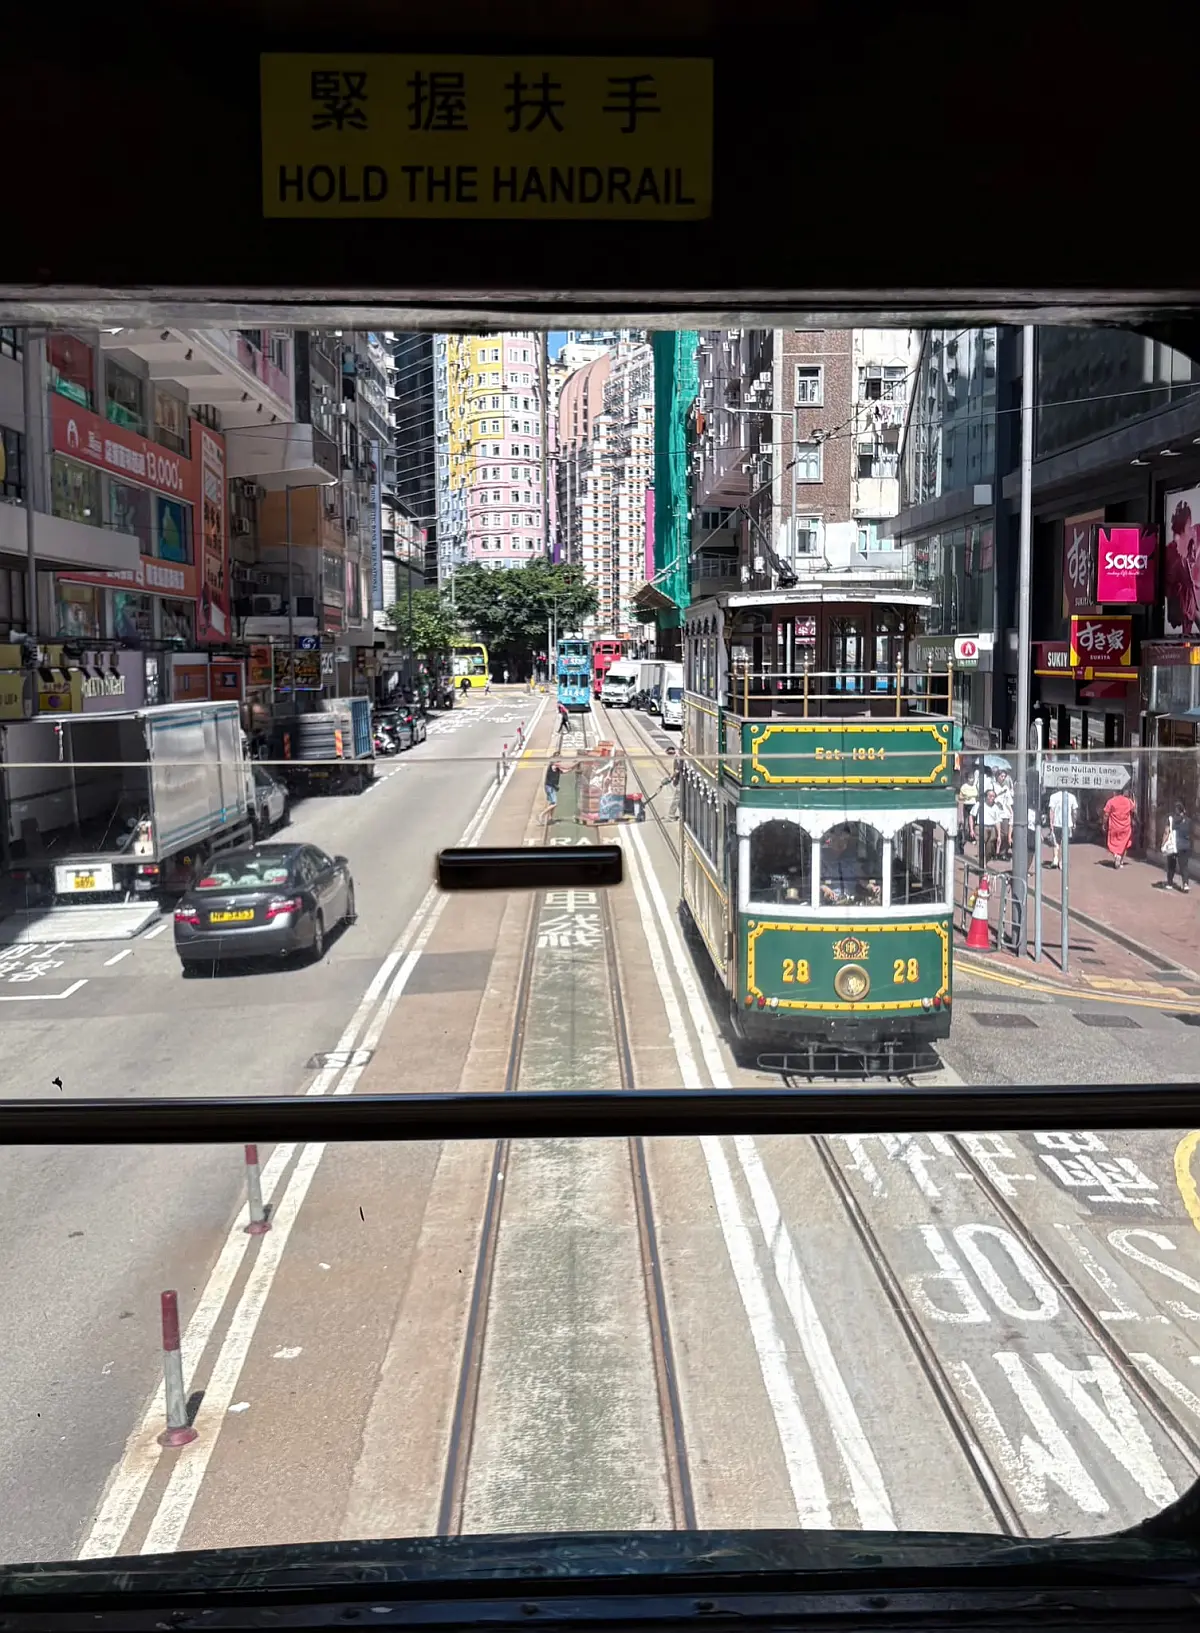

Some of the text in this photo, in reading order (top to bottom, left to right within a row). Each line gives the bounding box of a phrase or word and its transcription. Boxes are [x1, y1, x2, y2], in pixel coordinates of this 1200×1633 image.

[311, 71, 661, 132] 緊握扶手
[279, 165, 696, 205] HOLD THE HANDRAIL
[1067, 527, 1094, 589] すき
[1077, 621, 1125, 654] すき家
[1047, 651, 1068, 668] SUKIY
[815, 747, 886, 760] Est. 1884
[1046, 764, 1117, 775] Stone Nullah Lane
[782, 958, 811, 983] 28
[892, 957, 919, 983] 28
